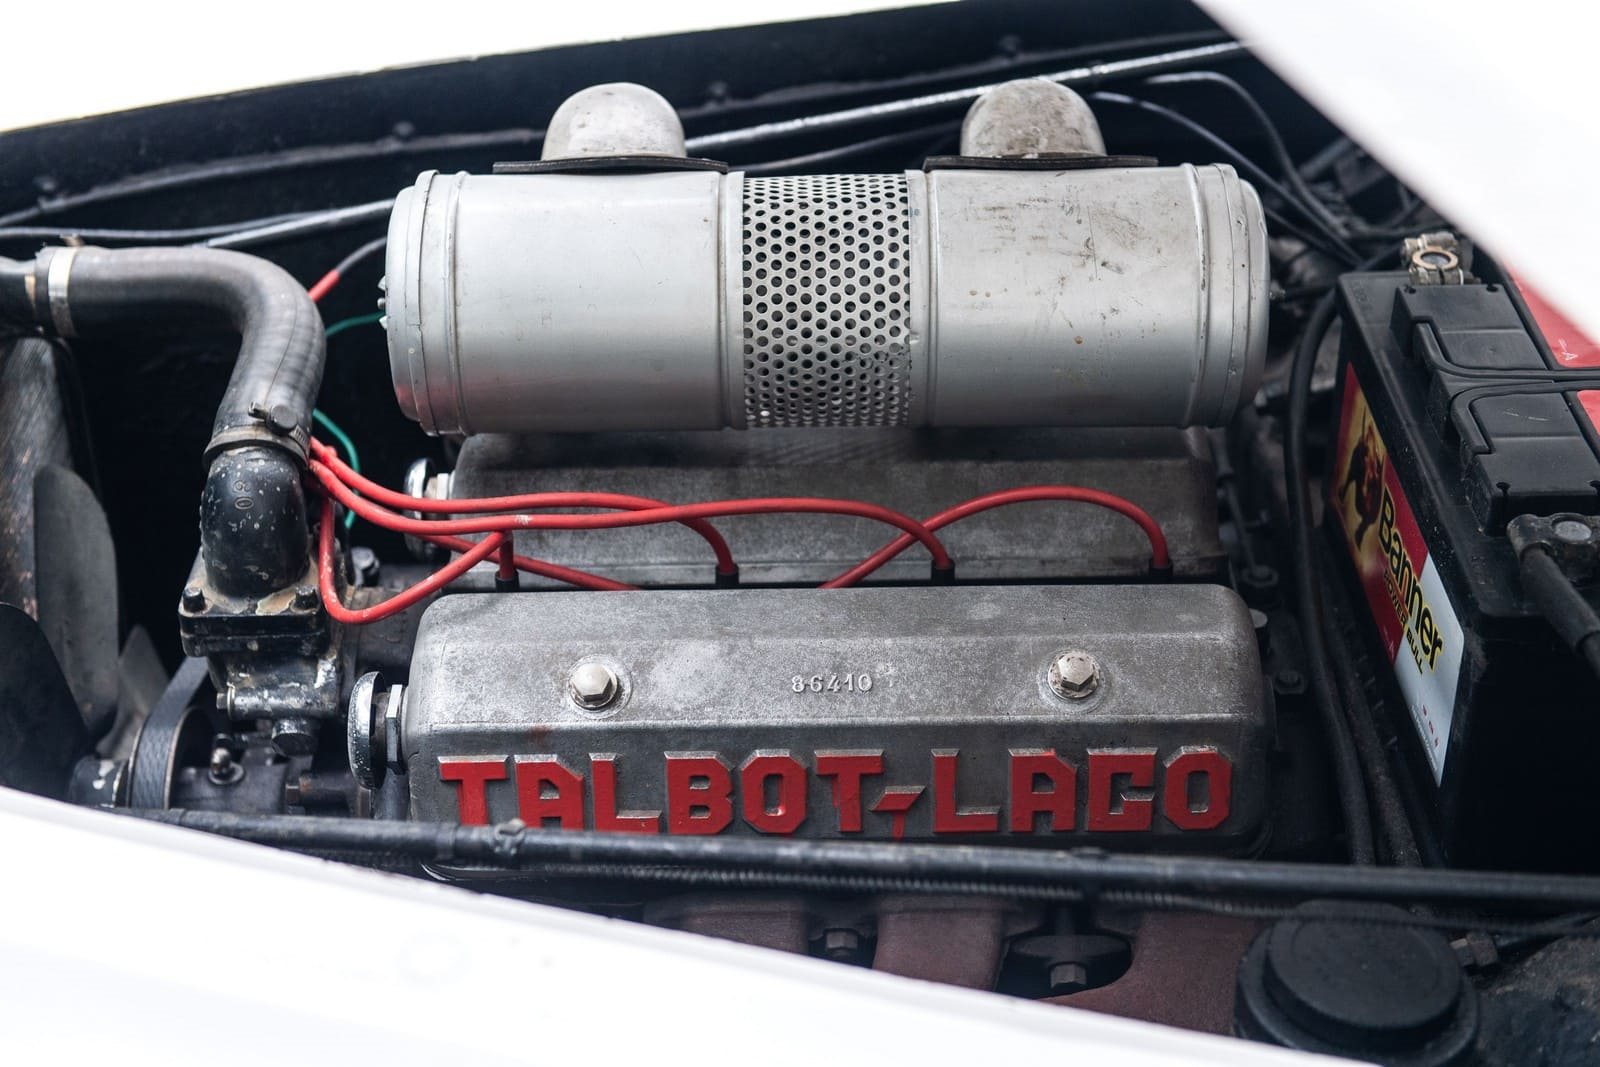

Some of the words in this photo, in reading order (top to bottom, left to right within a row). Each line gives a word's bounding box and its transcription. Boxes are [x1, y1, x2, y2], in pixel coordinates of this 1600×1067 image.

[1380, 483, 1444, 673] Banner
[1384, 568, 1407, 626] POWER
[1406, 627, 1423, 675] BULL
[791, 673, 873, 693] 86410
